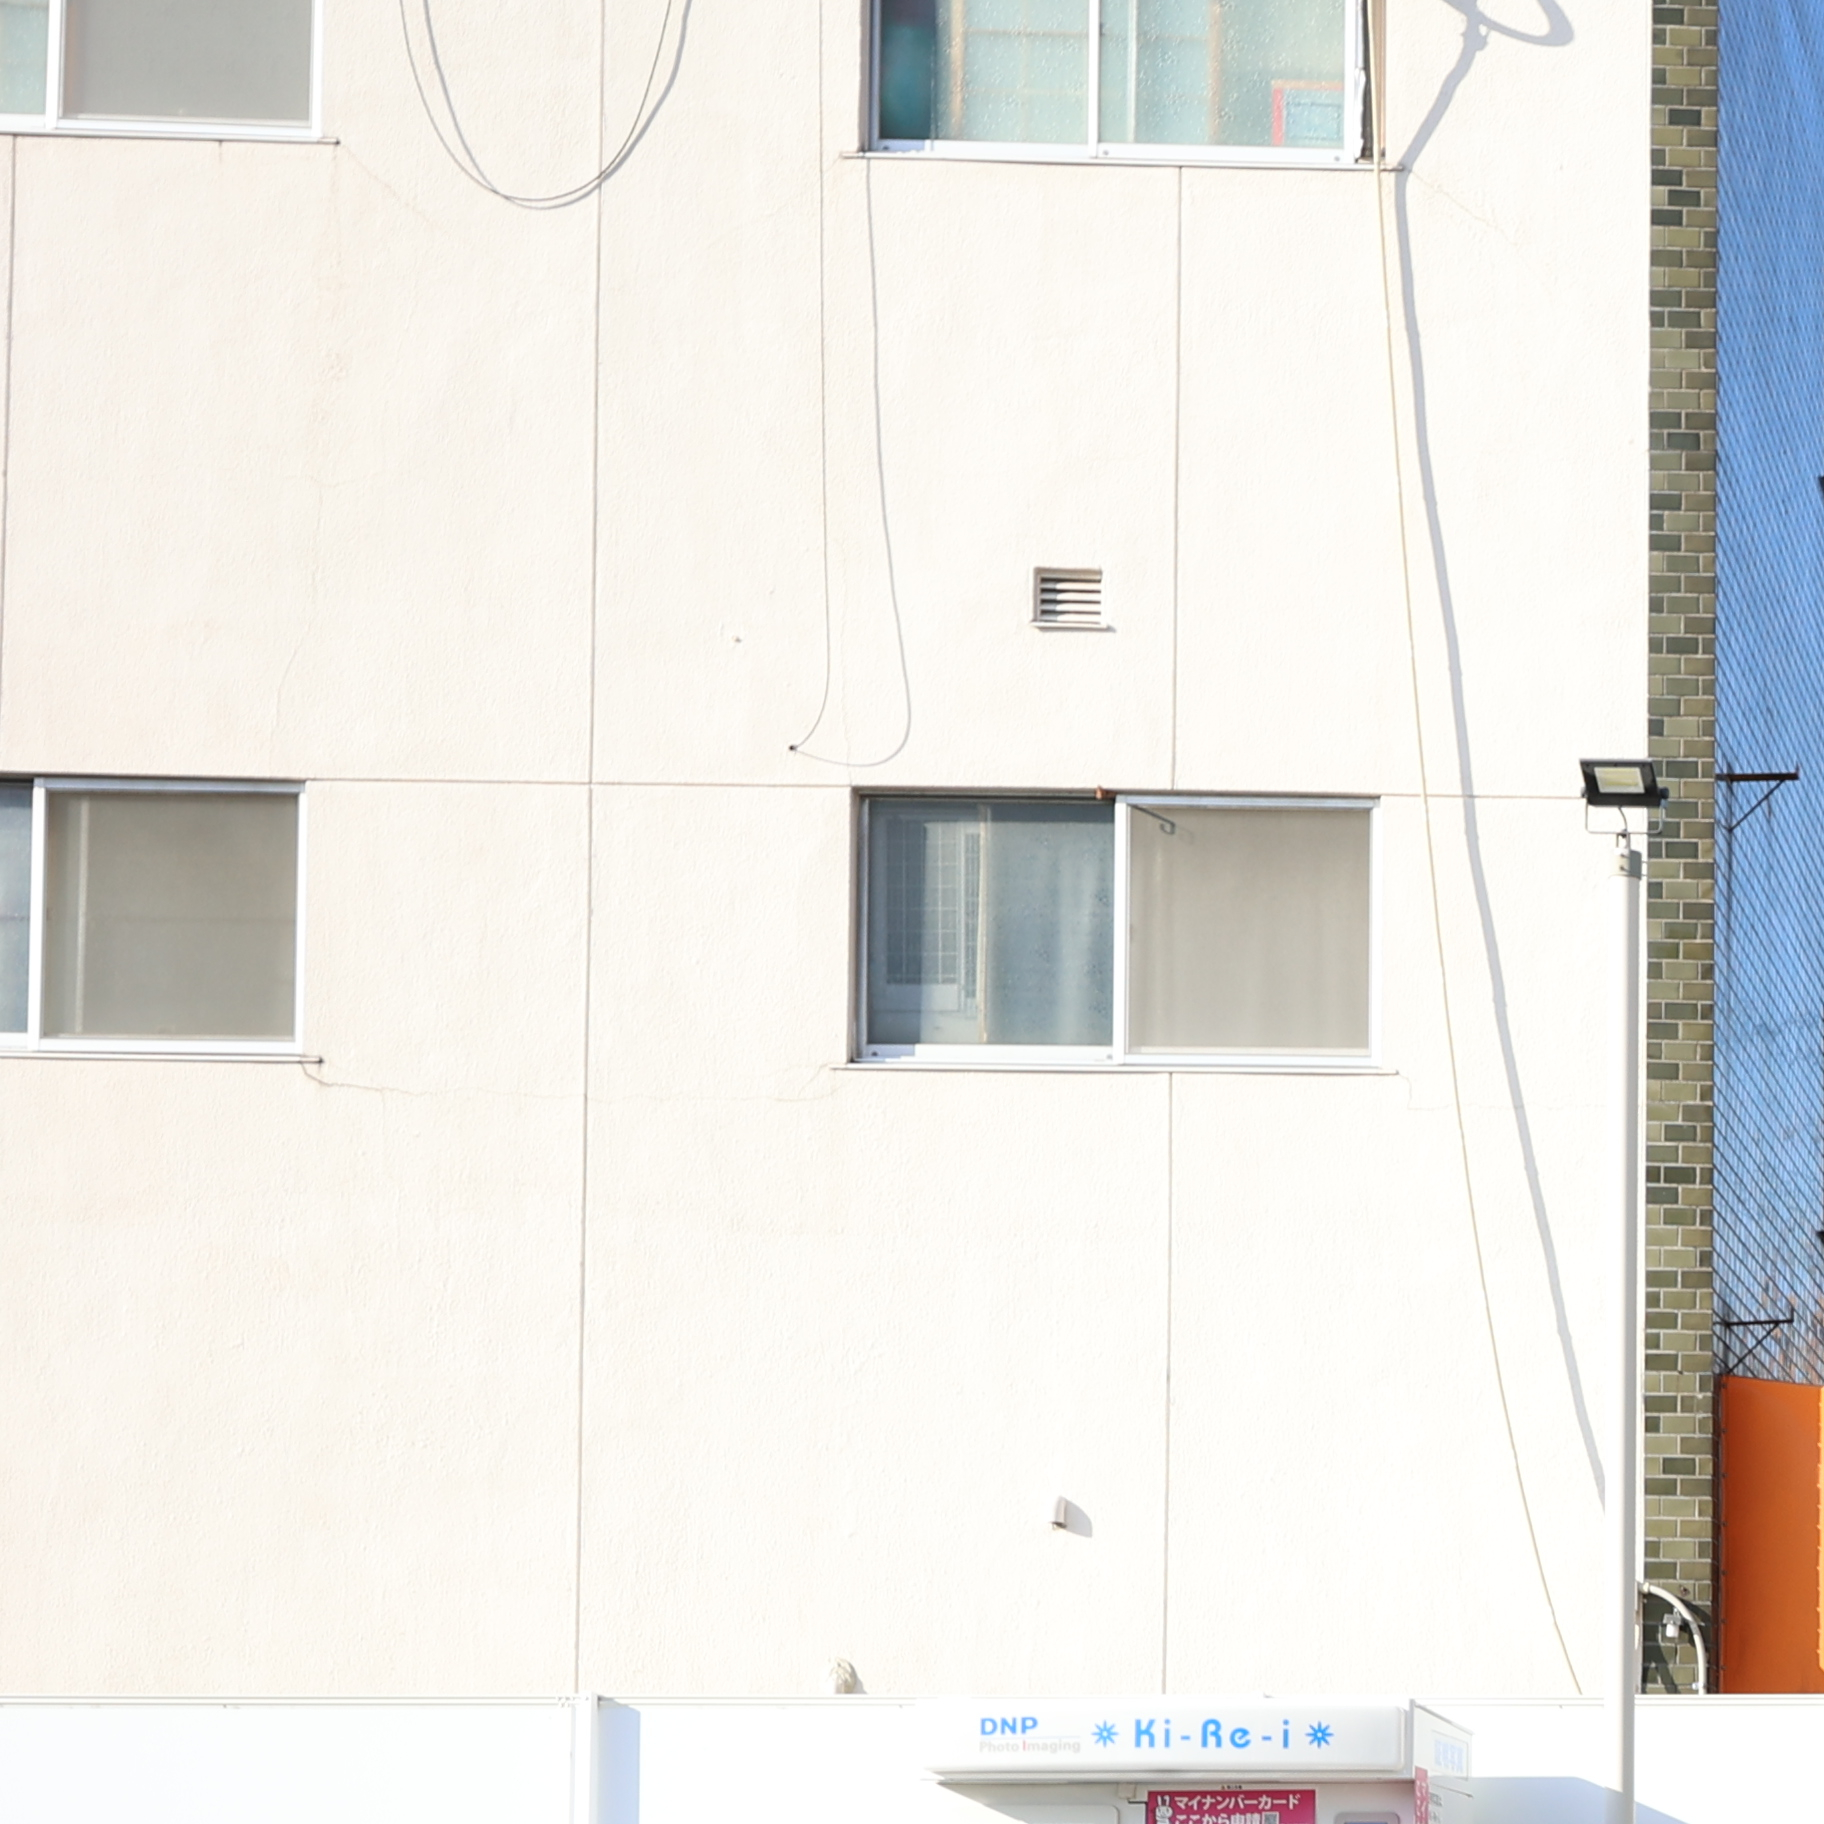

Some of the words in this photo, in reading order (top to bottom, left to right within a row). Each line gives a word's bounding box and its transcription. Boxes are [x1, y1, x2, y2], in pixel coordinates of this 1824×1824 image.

[980, 1717, 1038, 1735] DNP
[979, 1741, 1020, 1752] Photo
[1023, 1740, 1081, 1753] Imaging
[1174, 1794, 1301, 1811] マイナンバーカード
